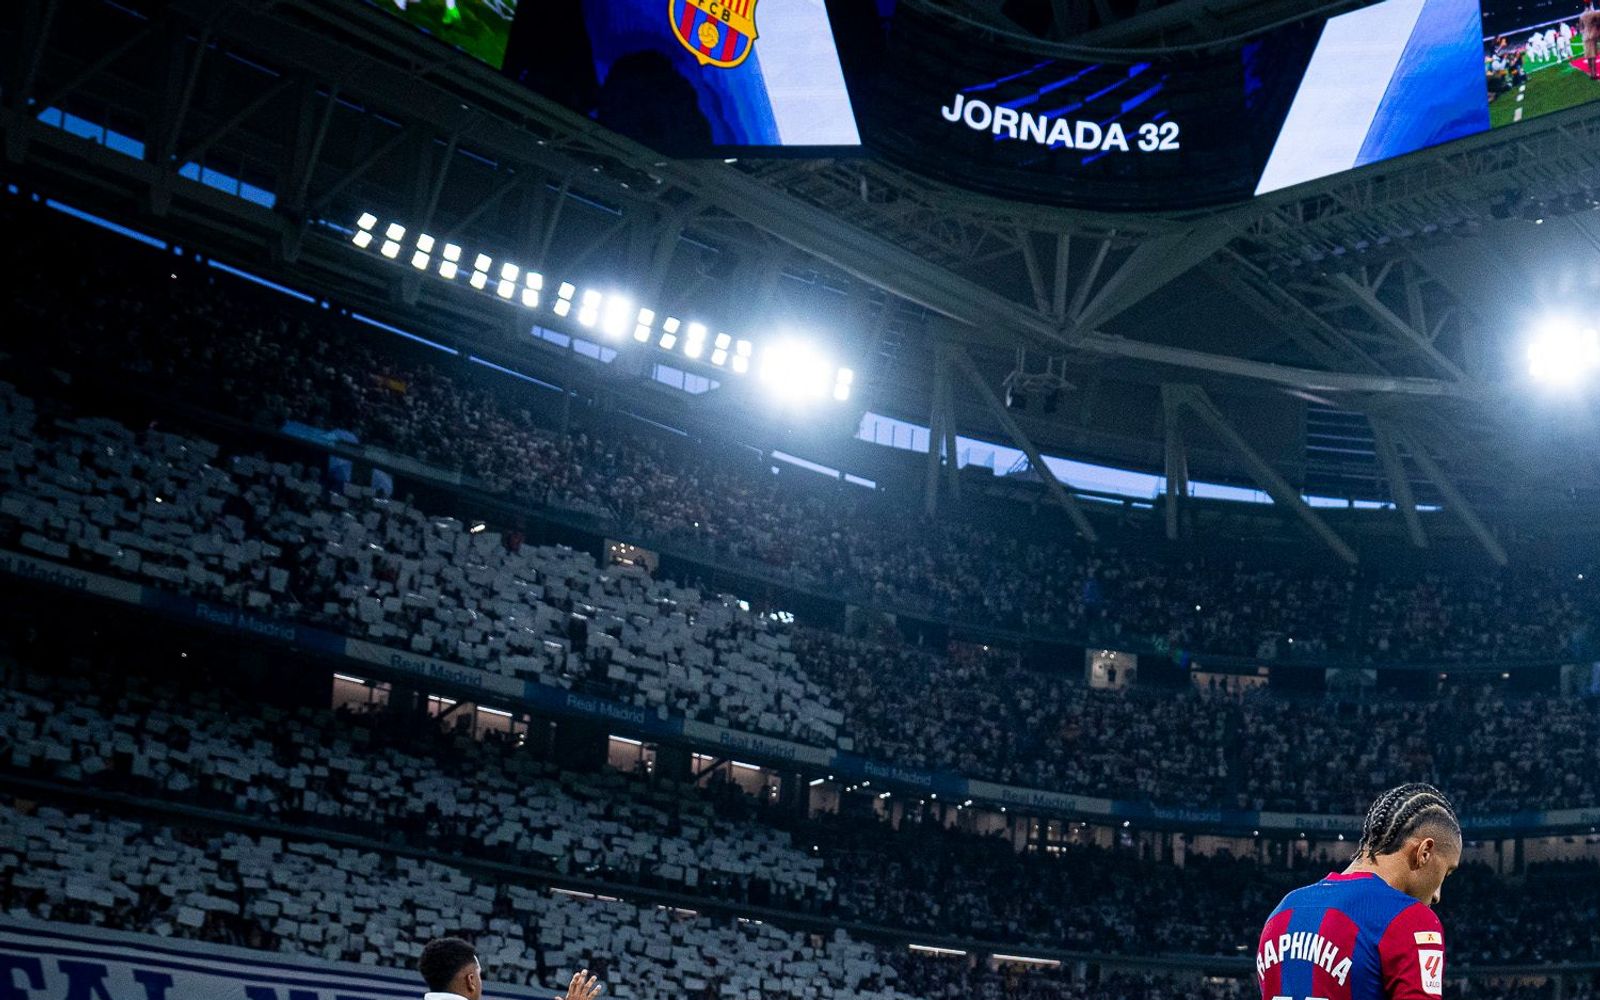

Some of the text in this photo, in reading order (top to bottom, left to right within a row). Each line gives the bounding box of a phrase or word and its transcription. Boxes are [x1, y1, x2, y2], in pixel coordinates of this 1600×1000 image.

[941, 93, 1181, 152] JORNADA 32
[1256, 931, 1352, 987] RAPHINHA
